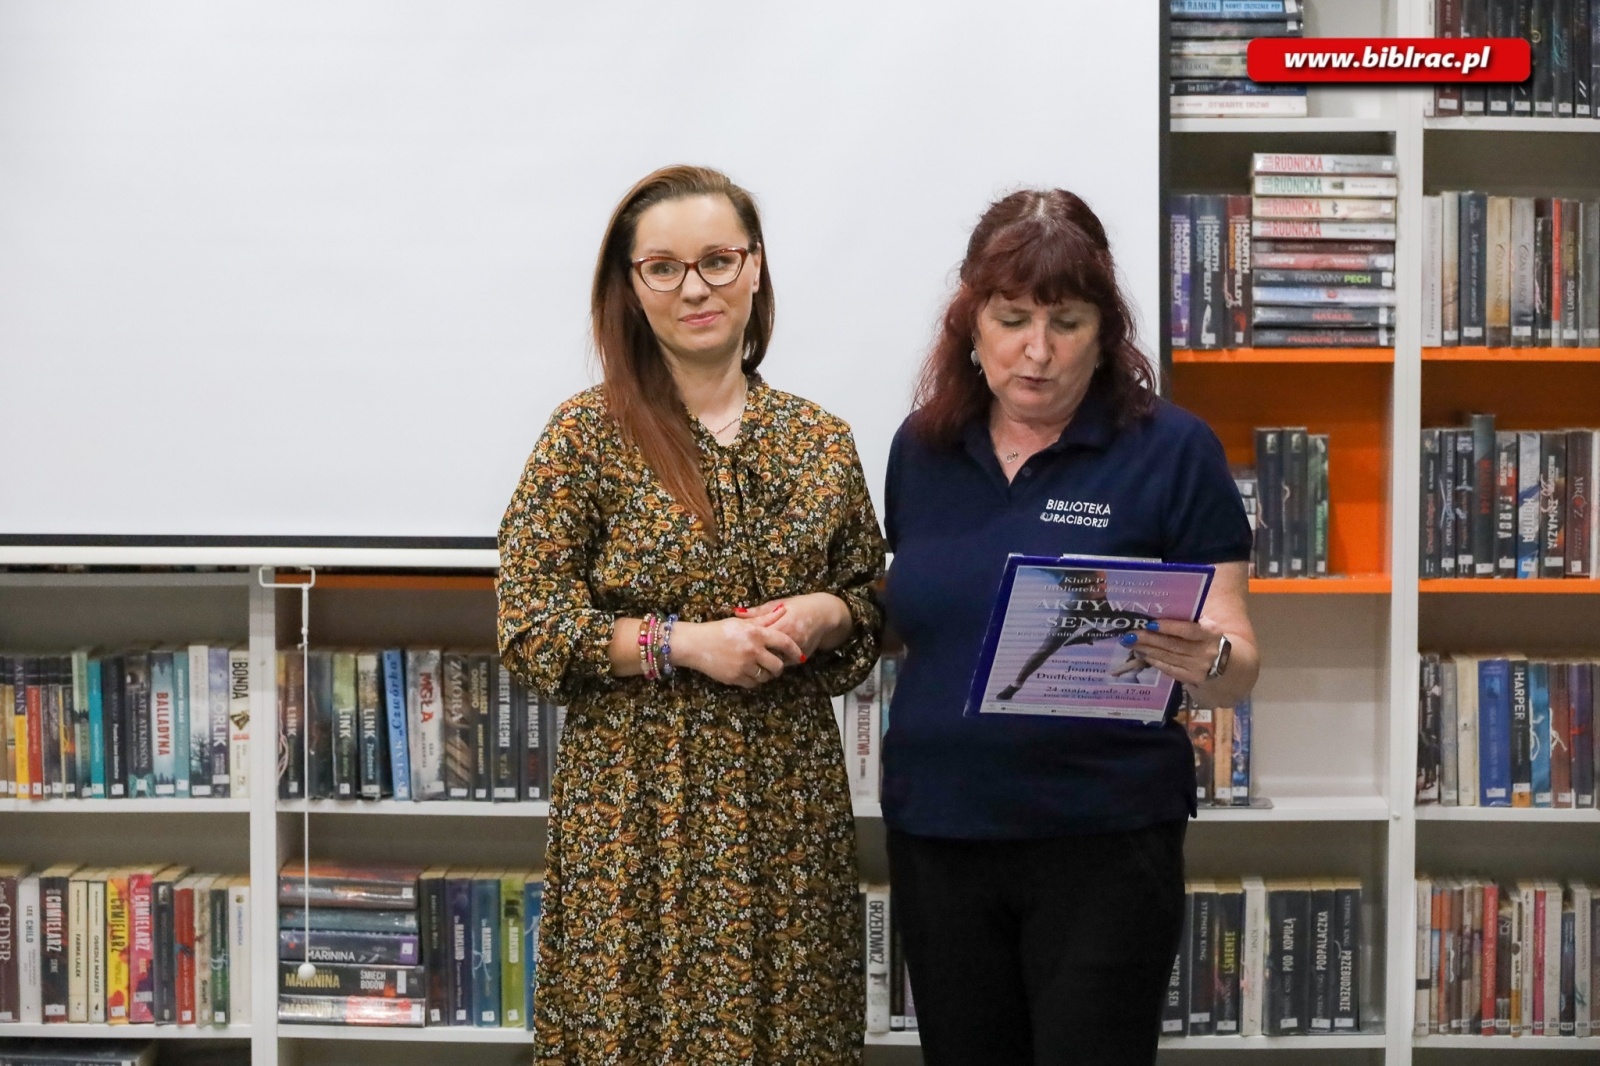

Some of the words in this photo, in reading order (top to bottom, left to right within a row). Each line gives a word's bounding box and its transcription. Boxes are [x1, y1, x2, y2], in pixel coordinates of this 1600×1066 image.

[1275, 156, 1323, 171] RUDNICKA
[1274, 177, 1322, 193] RUDNICKA
[1273, 199, 1321, 215] RUDNICKA
[1272, 221, 1321, 237] RUDNICKA
[1174, 224, 1182, 306] ROSENFELDT
[1182, 224, 1190, 274] HJORTH
[1212, 225, 1220, 271] HJORTH
[1242, 224, 1250, 274] HJORTH
[1344, 275, 1372, 285] PECH
[1566, 280, 1575, 309] LANGFUS
[1046, 499, 1111, 515] BIBLIOTEKA
[1053, 514, 1109, 528] RACIBORZU
[1547, 499, 1559, 549] INWAZJA
[1036, 599, 1170, 614] AKTYWNY
[1045, 616, 1148, 630] SENIOR
[232, 662, 249, 700] BONDA
[1036, 673, 1104, 682] Dudkiewicz
[1065, 665, 1107, 674] Joanna
[419, 673, 435, 723] MGŁA
[450, 661, 463, 722] ZMORA
[1514, 672, 1526, 721] HARPER
[156, 692, 170, 756] BALLADYNA
[287, 706, 297, 737] LINK
[339, 709, 352, 738] LINK
[363, 708, 376, 739] LINK
[499, 704, 511, 748] MAŁECKI
[528, 705, 539, 748] MAŁECKI
[857, 705, 871, 756] DZIEDZICTWO
[140, 718, 149, 768] ATKINSON
[366, 743, 375, 779] Złudzenie
[0, 903, 12, 961] CEDER
[26, 920, 34, 944] CHILD
[46, 895, 62, 952] CHMIELARZ
[110, 898, 126, 953] CHMIELARZ
[135, 894, 150, 951] CHMIELARZ
[868, 901, 885, 965] GRZĘDOWICZ
[1200, 901, 1209, 938] STEPHEN
[1283, 918, 1297, 951] KOPUŁĄ
[454, 924, 465, 960] MARKLUND
[1199, 939, 1208, 961] KING
[1223, 931, 1236, 975] LŚNIENIE
[1250, 929, 1259, 953] KING
[1316, 911, 1329, 971] PODPALACZKA
[360, 969, 386, 980] ŚMIECH
[1283, 954, 1294, 972] POD
[1339, 950, 1352, 1012] PRZEBUDZENIE
[360, 981, 385, 990] BOGÓW
[1168, 991, 1180, 1007] SEN
